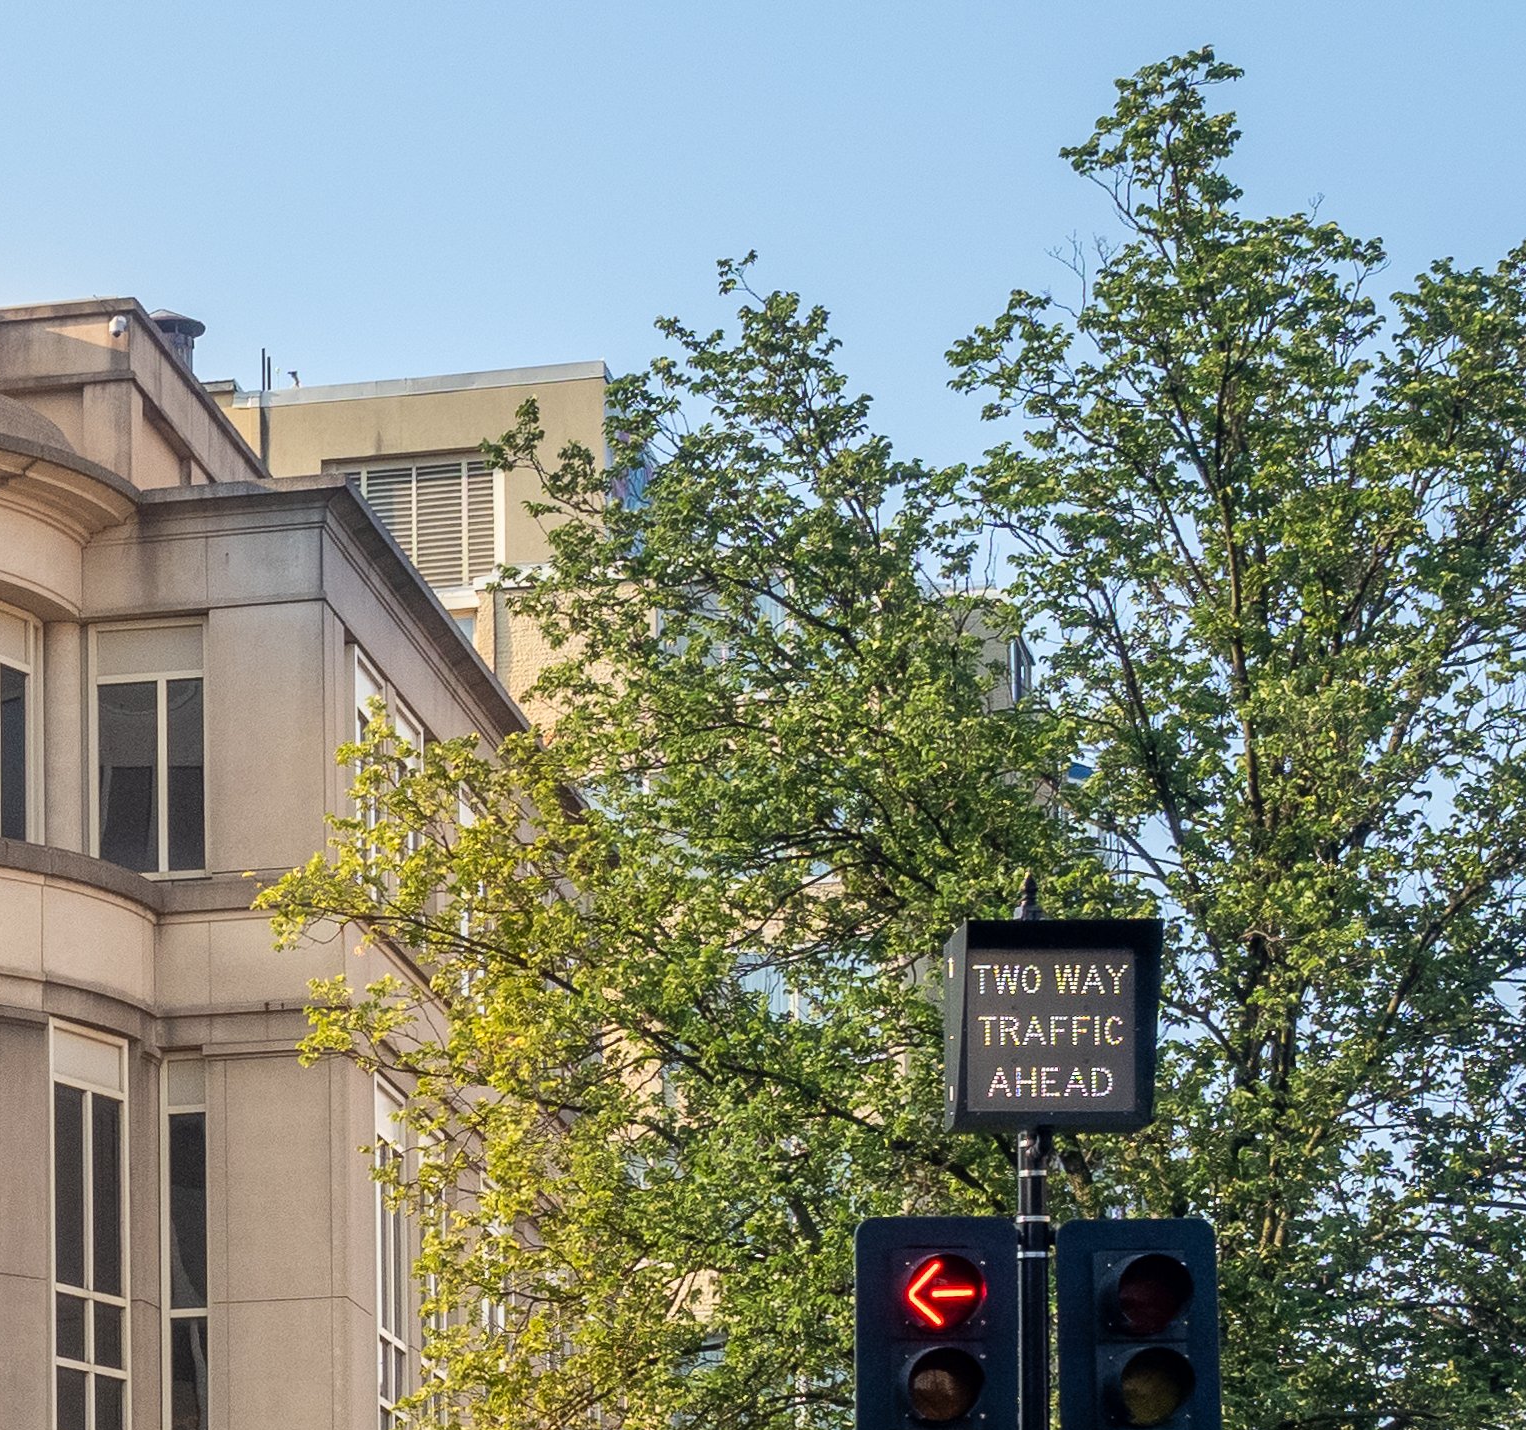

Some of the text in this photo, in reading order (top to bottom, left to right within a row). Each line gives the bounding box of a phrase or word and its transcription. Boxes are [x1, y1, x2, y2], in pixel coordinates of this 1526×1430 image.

[972, 964, 1128, 994] TWO WAY
[978, 1015, 1124, 1046] TRAFFIC
[987, 1067, 1113, 1097] AHEAD
